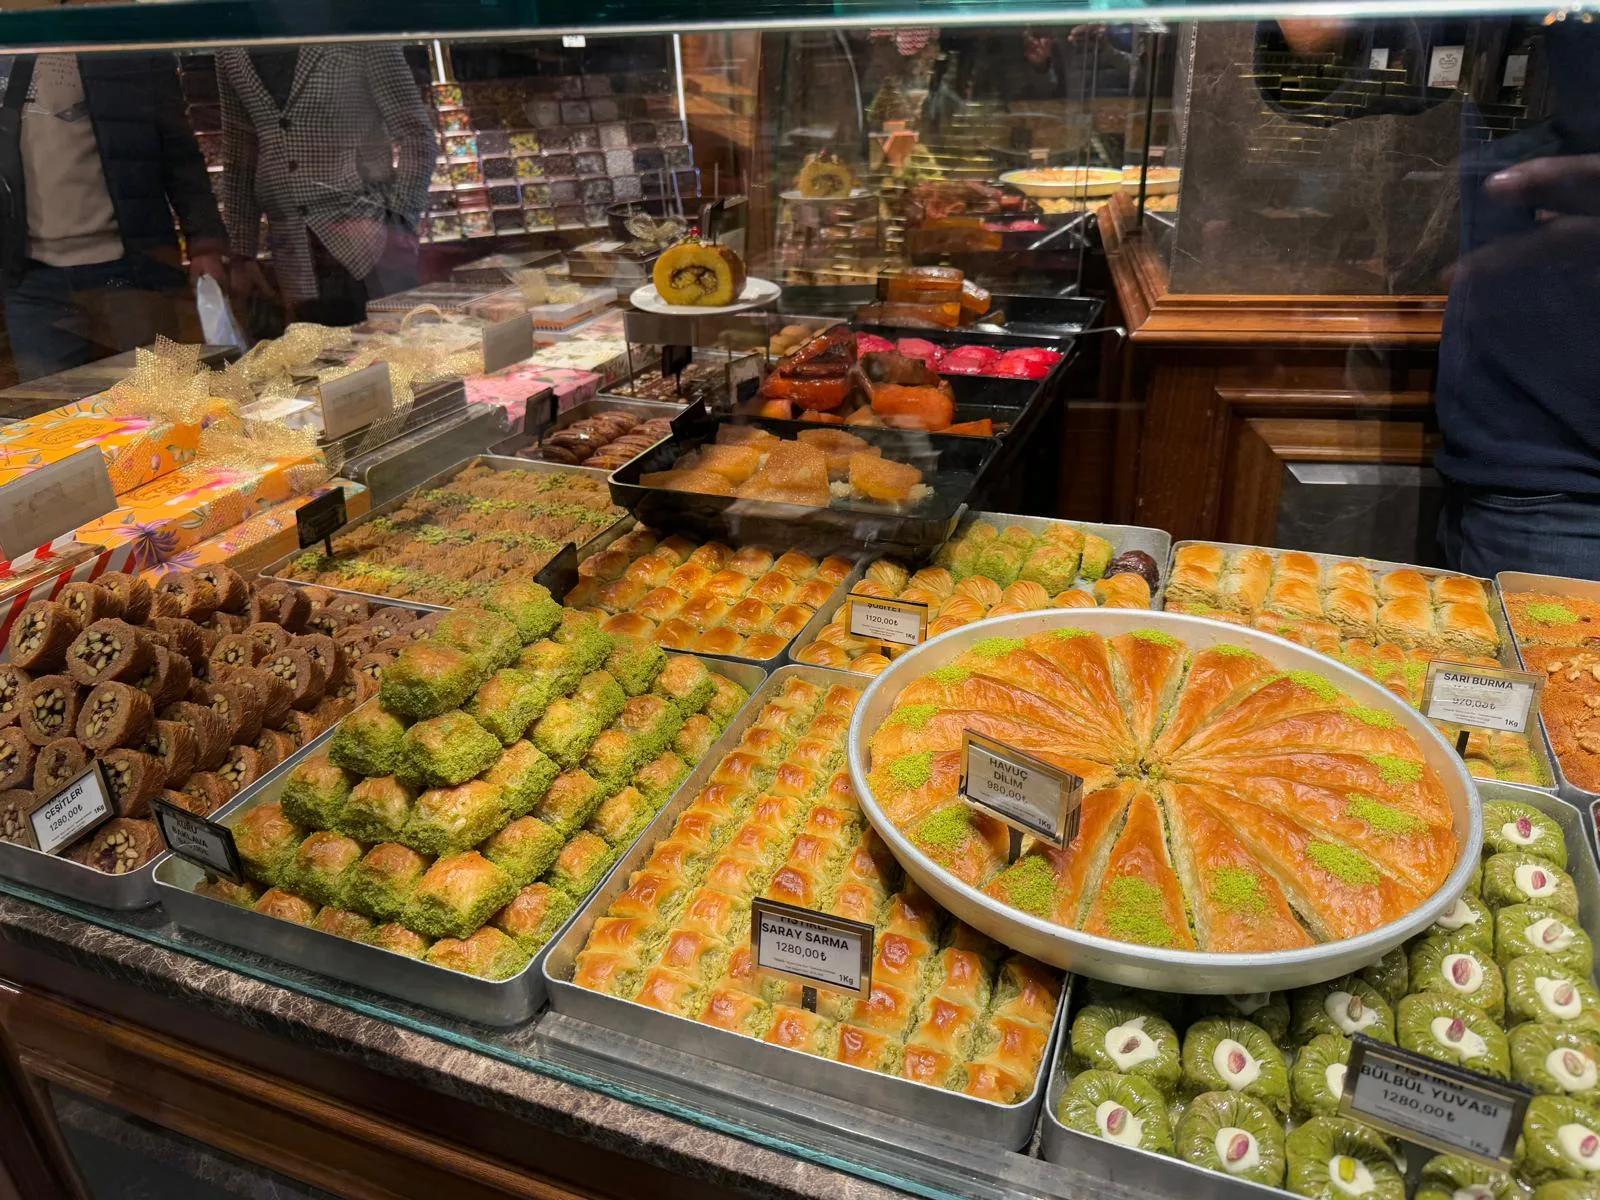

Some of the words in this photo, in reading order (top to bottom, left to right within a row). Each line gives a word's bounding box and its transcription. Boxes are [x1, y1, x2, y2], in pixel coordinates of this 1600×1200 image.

[865, 614, 899, 626] 1120,00₺
[1443, 672, 1470, 684] SARI
[1472, 676, 1513, 690] BURMA
[1504, 718, 1519, 728] 1Kg
[989, 757, 1028, 781] HAVUÇ
[44, 784, 83, 820] ÇEŞİTLERİ
[49, 803, 84, 832] 1280,00₺
[1038, 818, 1051, 830] 1Kg
[762, 922, 802, 940] SARAY
[805, 932, 849, 951] SARMA
[776, 941, 827, 962] 1280,00₺
[839, 974, 854, 986] 1Kg
[1360, 1063, 1425, 1095] BÜLBÜL
[1431, 1087, 1499, 1118] YUVASI
[1382, 1089, 1456, 1123] 1280,00₺
